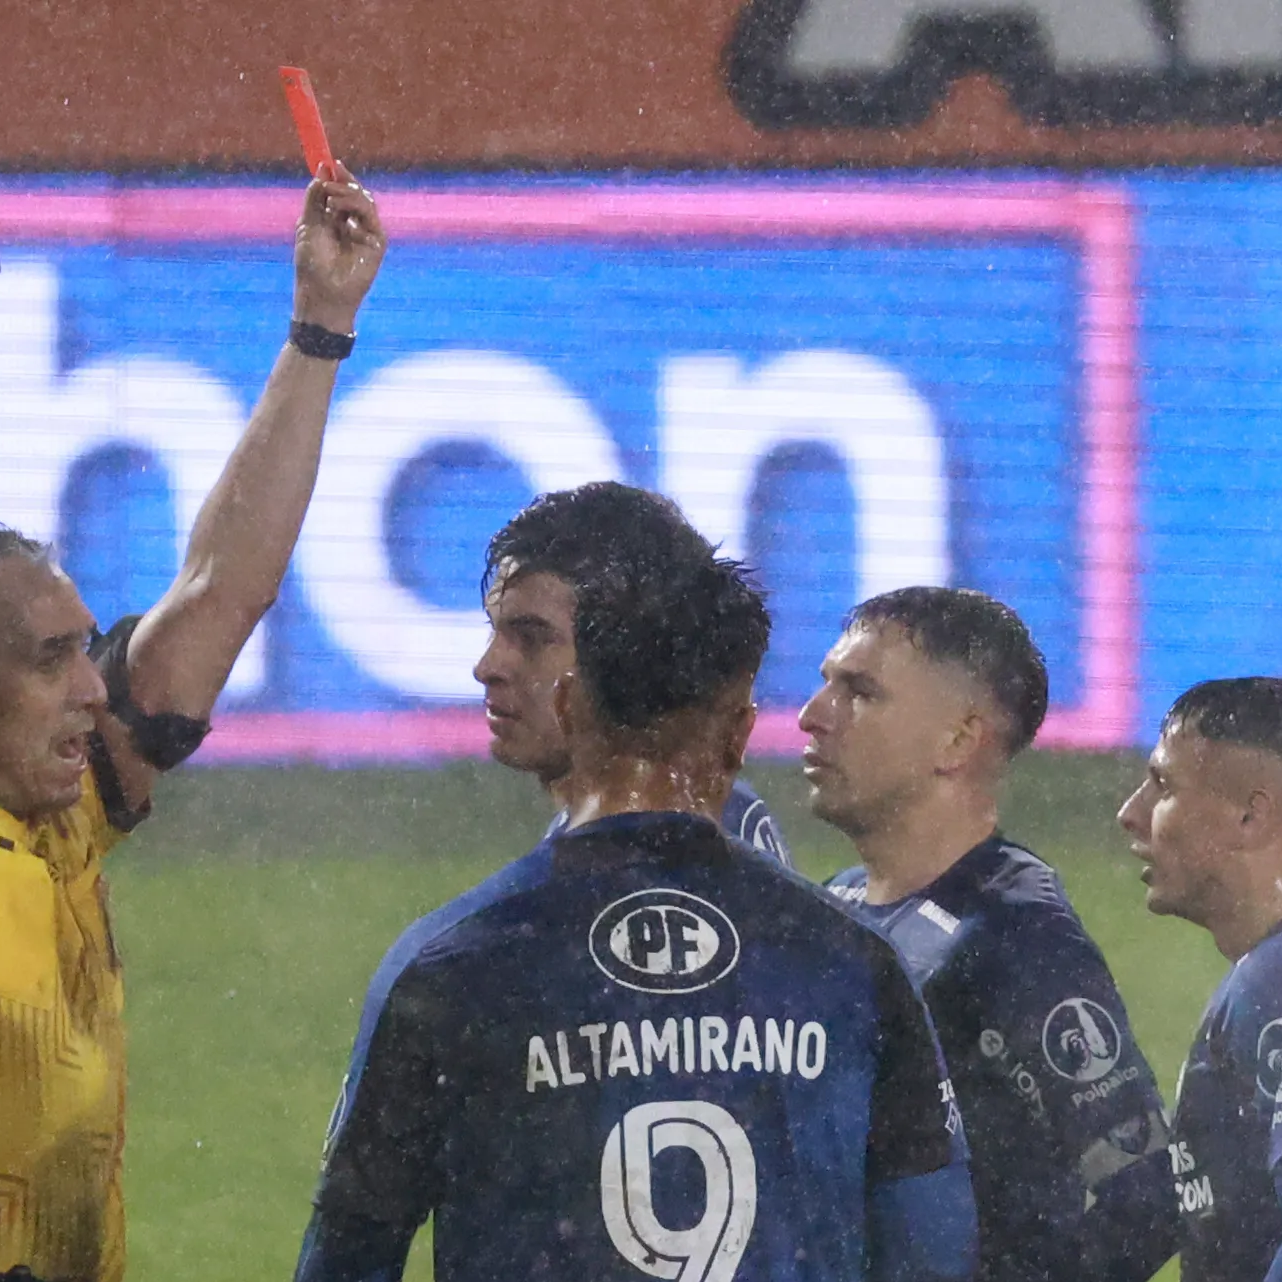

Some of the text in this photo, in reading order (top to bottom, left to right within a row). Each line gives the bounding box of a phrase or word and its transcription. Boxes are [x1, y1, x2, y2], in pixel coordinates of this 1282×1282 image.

[626, 906, 699, 972] PF
[525, 1015, 828, 1093] ALTAMIRANO
[1071, 1065, 1140, 1108] Polpaico
